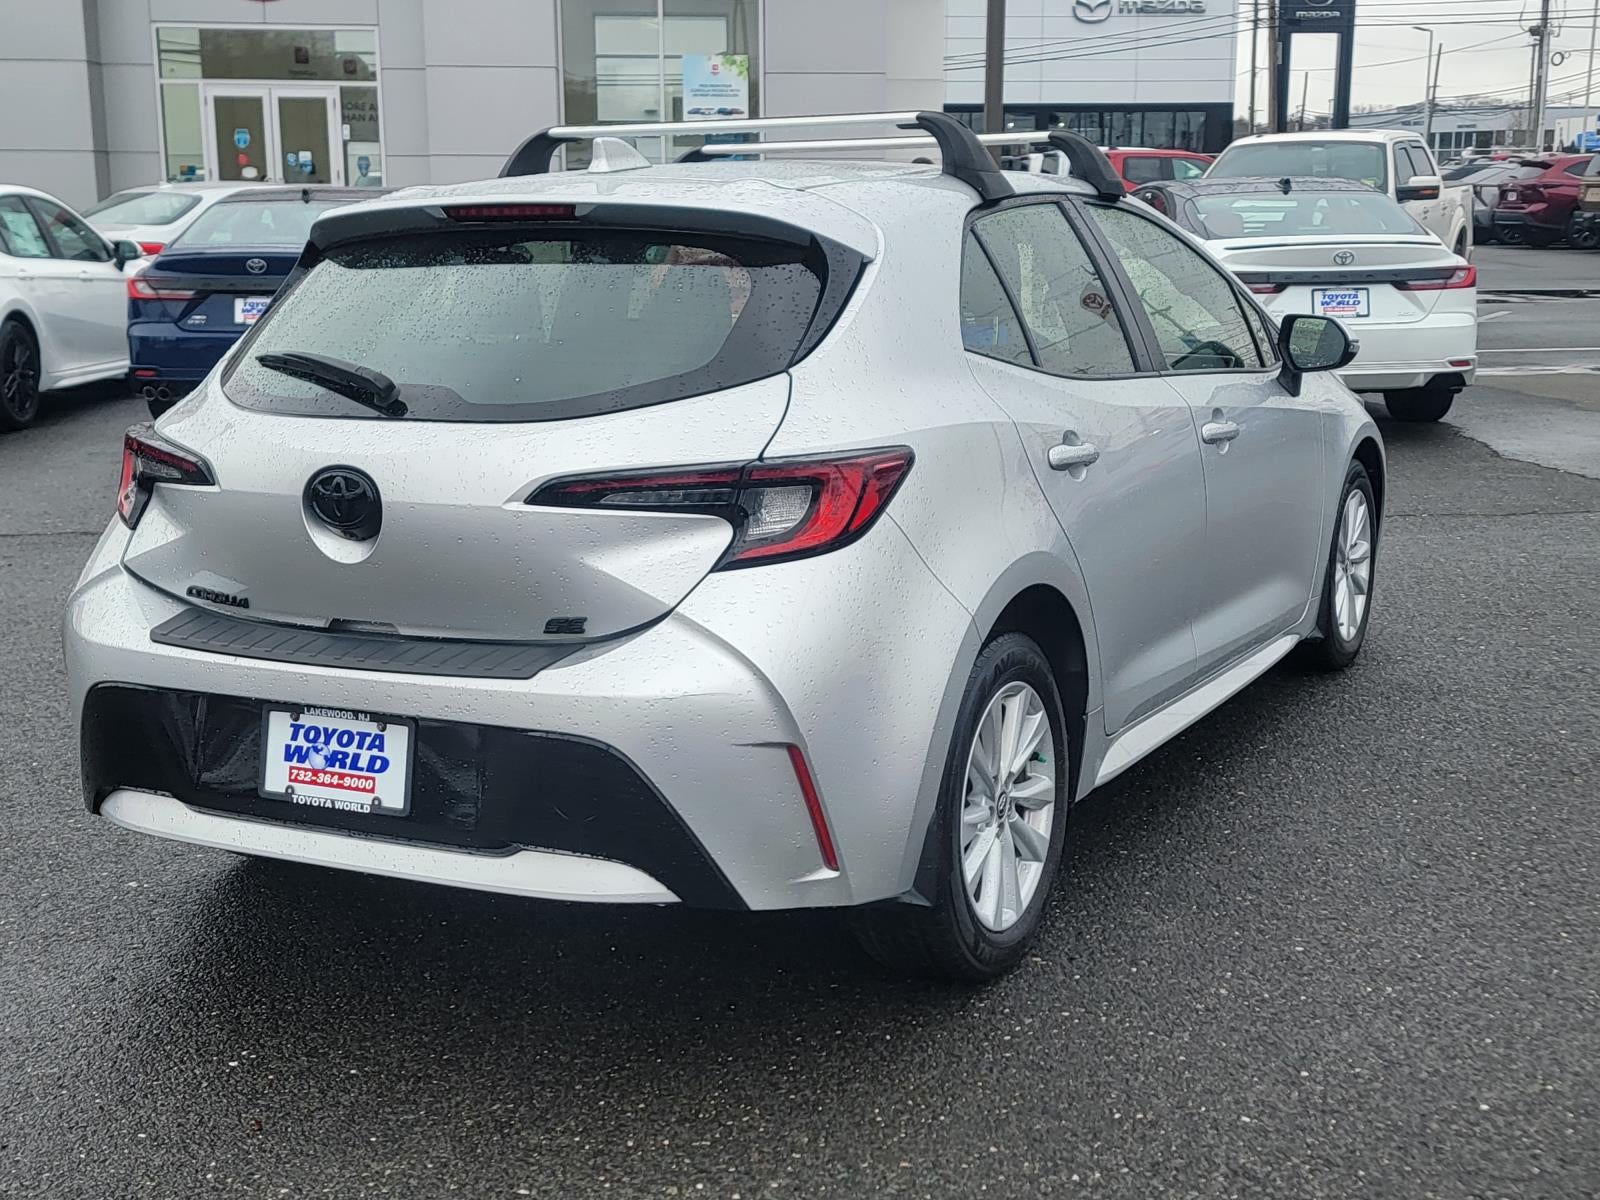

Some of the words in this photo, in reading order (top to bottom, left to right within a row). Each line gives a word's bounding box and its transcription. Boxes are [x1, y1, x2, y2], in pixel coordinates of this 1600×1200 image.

[543, 617, 588, 634] SE
[358, 713, 370, 722] NJ
[289, 723, 385, 753] TOYOTA
[284, 743, 390, 774] WORLD
[290, 769, 374, 790] 732-364-9000
[292, 794, 333, 809] TOYOTA
[334, 800, 371, 814] WORLD
